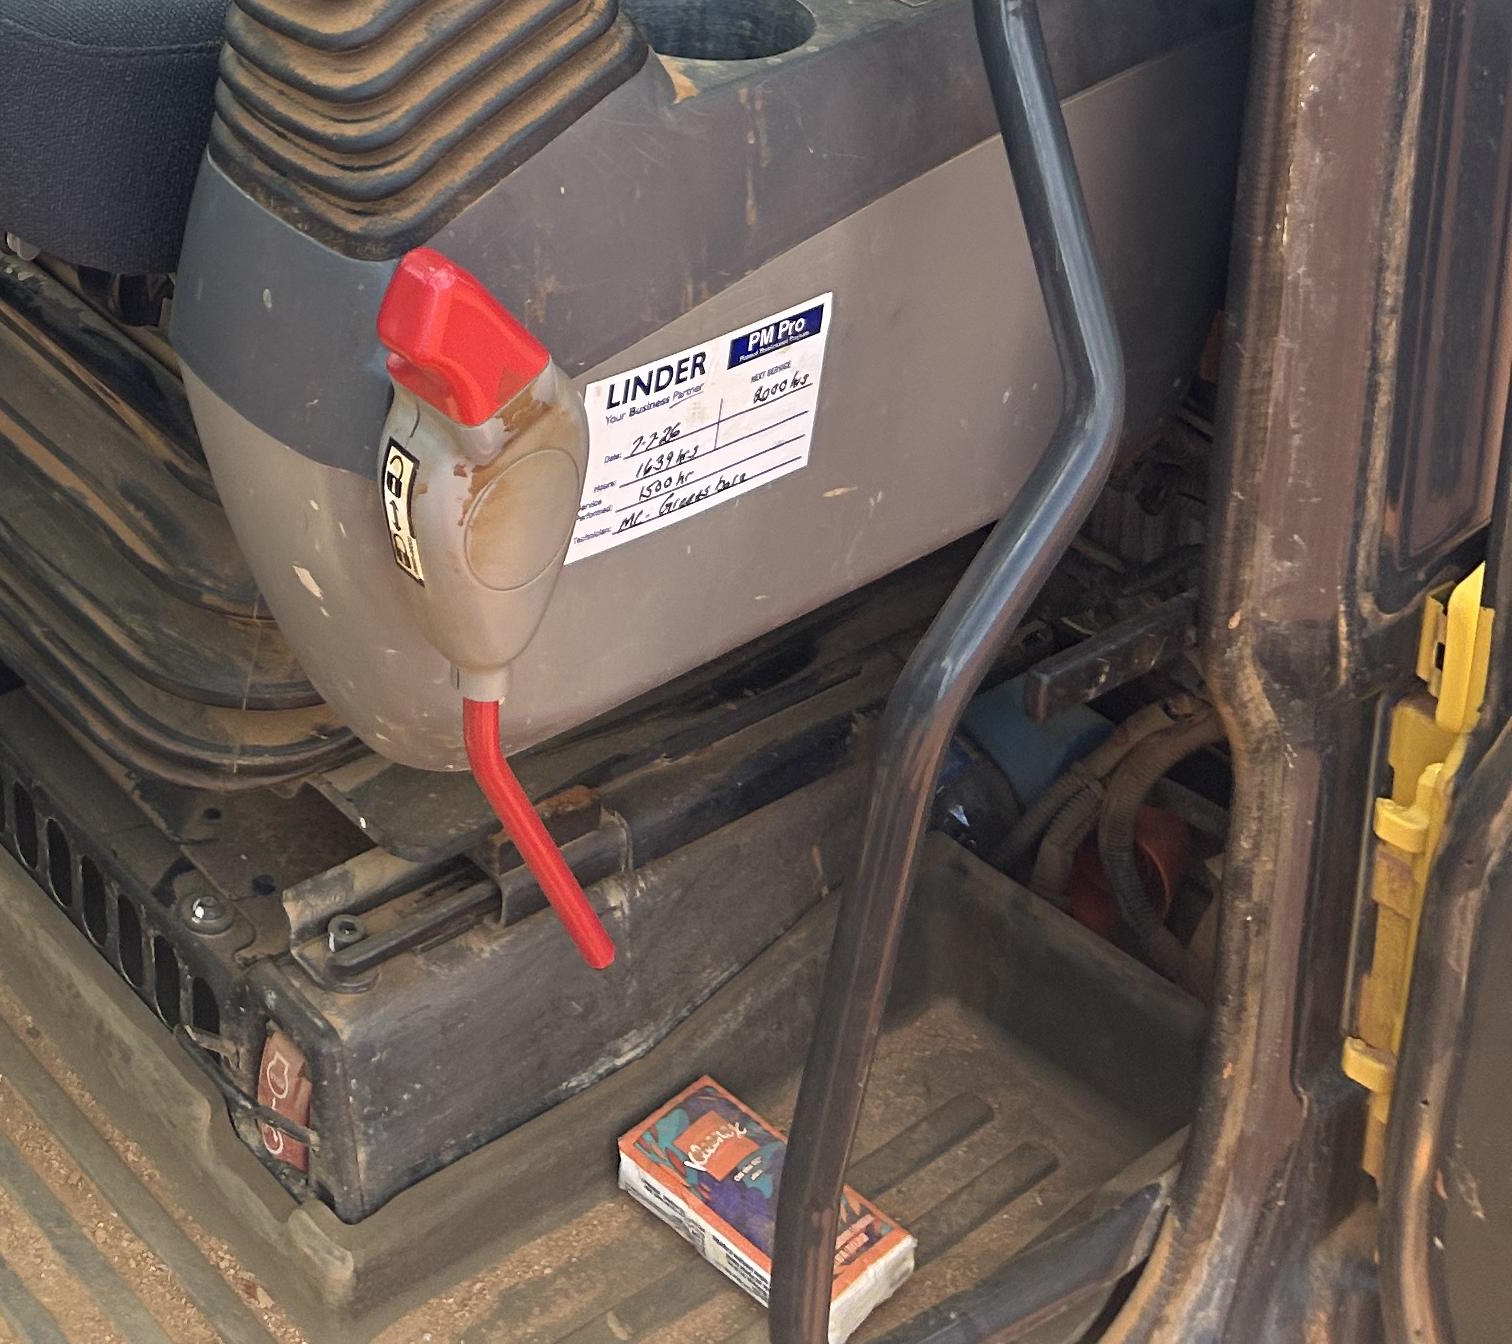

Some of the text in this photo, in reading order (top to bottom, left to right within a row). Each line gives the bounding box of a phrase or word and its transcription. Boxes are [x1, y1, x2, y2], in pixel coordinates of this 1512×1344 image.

[748, 318, 805, 351] PM Pro
[606, 351, 706, 409] LINDER
[605, 383, 705, 426] Your Business Partner
[604, 453, 622, 463] Date:
[580, 500, 602, 510] ervice
